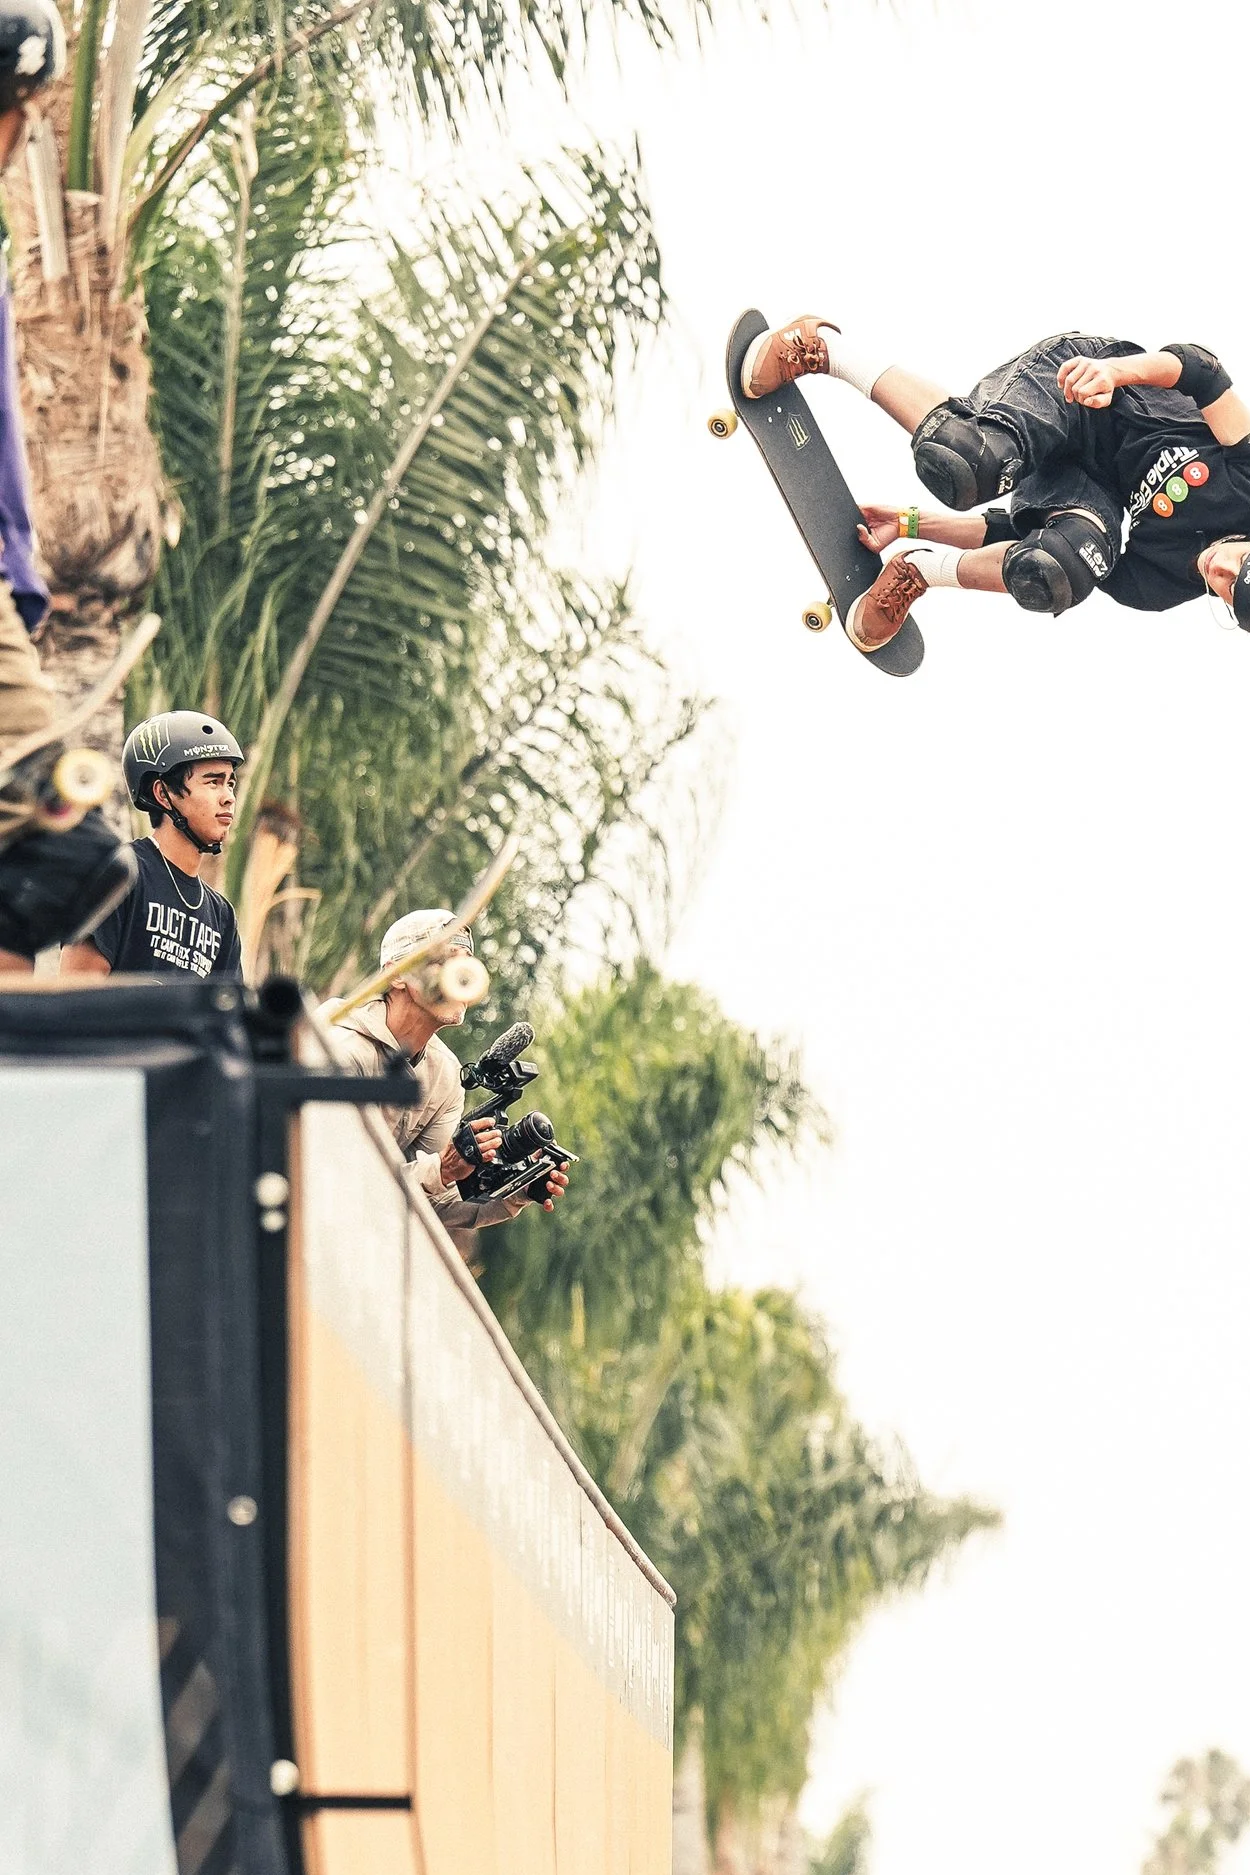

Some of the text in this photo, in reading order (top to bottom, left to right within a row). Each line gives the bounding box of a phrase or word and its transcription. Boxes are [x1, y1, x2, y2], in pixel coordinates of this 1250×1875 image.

[1146, 446, 1198, 485] Triple
[183, 744, 231, 757] MONSTER
[146, 901, 222, 961] DUCT TAPE
[150, 934, 161, 948] IT
